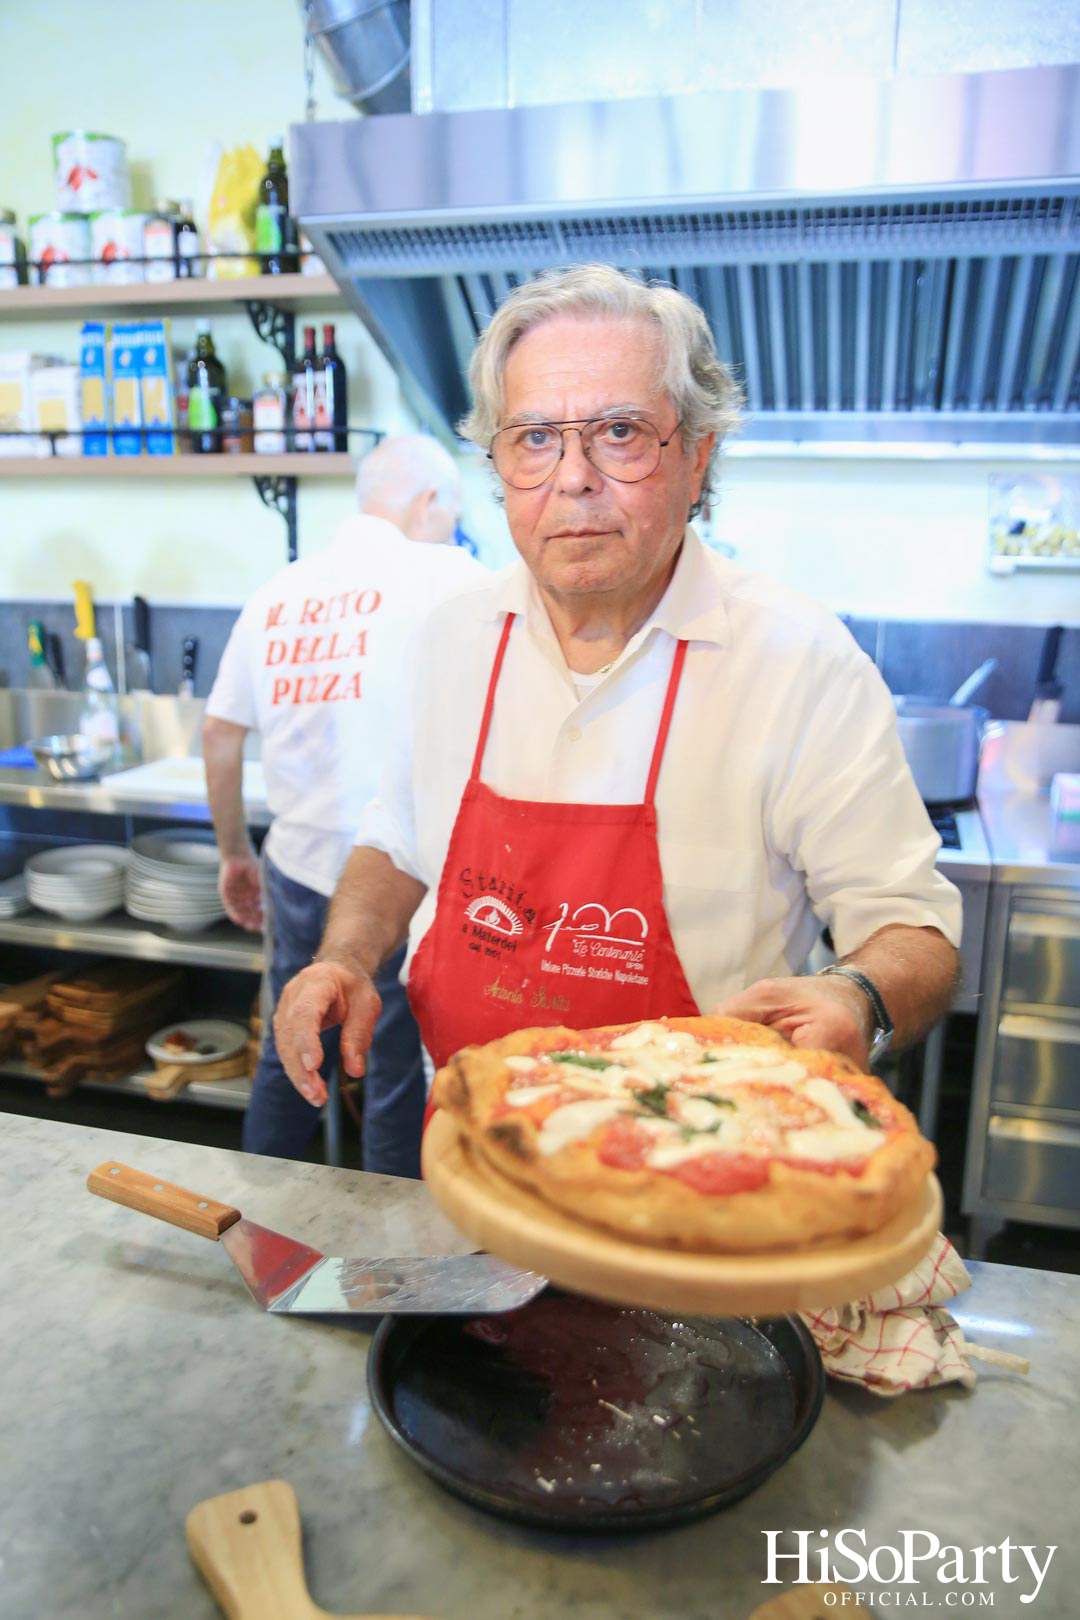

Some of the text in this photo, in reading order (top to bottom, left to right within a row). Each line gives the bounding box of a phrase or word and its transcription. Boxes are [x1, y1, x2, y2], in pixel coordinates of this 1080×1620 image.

[300, 588, 381, 624] RITO
[265, 628, 367, 666] DELLA
[272, 671, 361, 705] PIZZA
